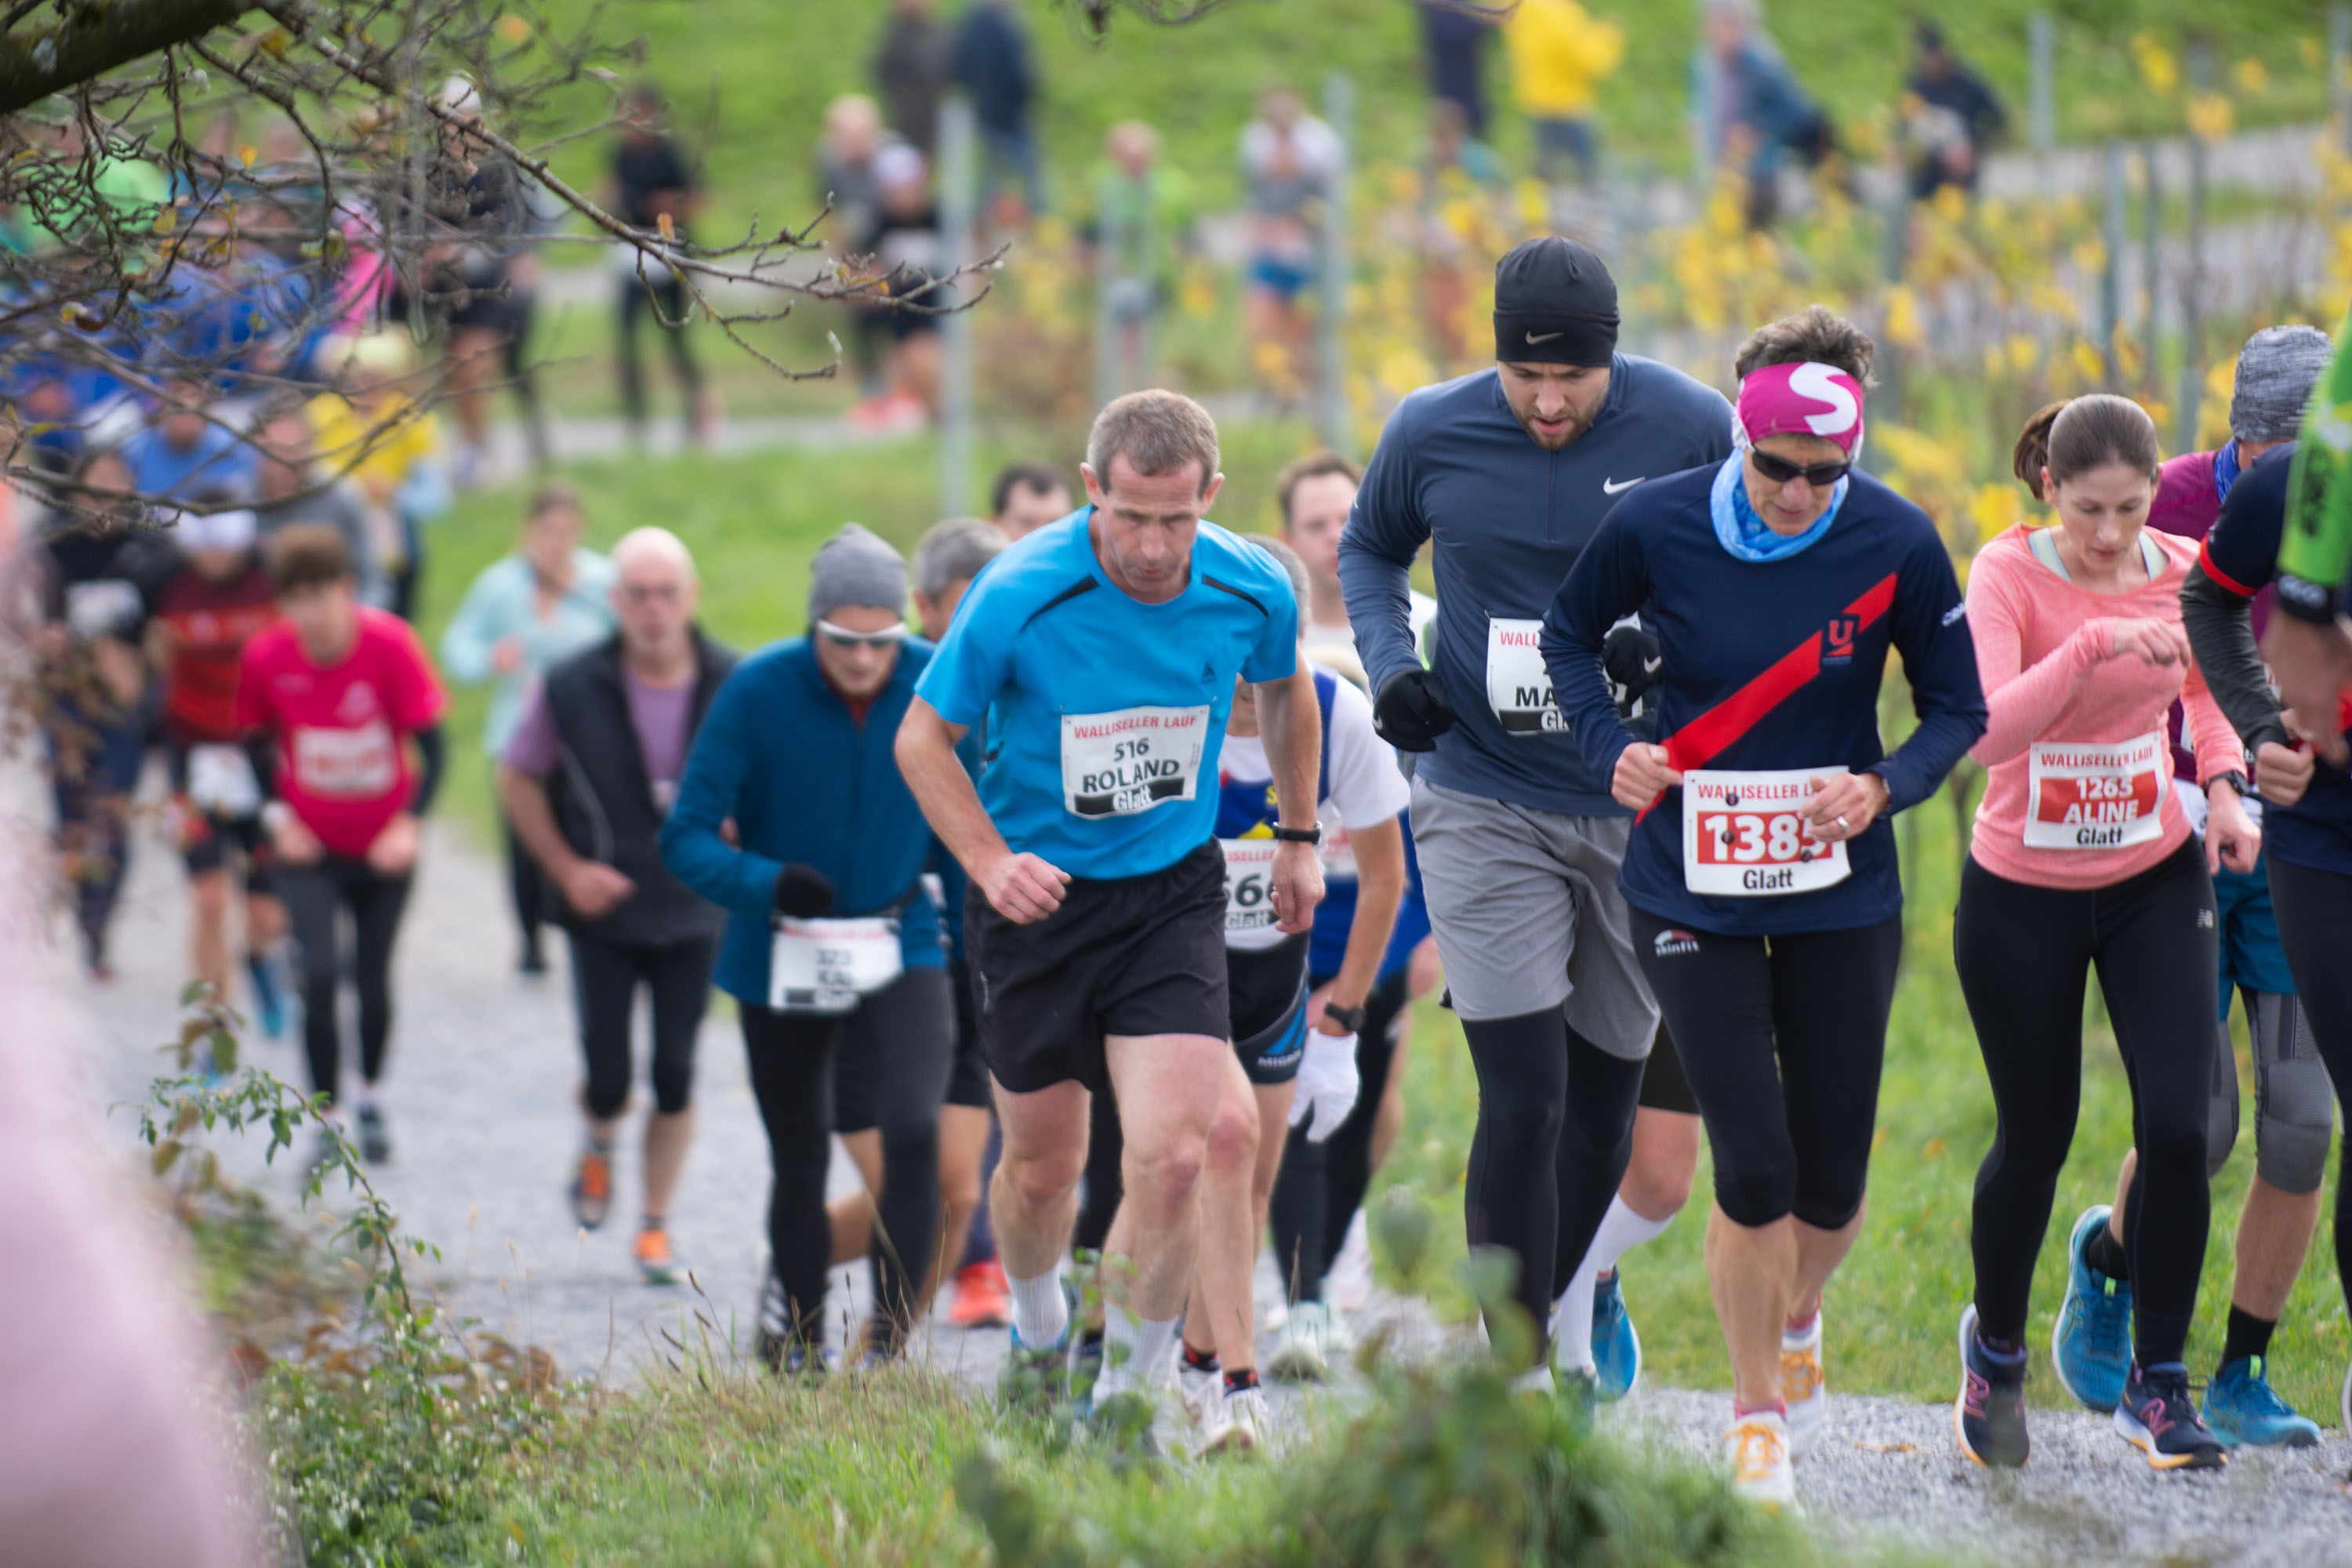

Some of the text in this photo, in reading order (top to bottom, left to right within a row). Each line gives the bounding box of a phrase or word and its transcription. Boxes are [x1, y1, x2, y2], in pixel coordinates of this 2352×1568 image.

[1073, 714, 1198, 739] WALLISELLER LAUF
[1541, 710, 1570, 731] Gl
[1113, 737, 1150, 762] 516
[2041, 752, 2129, 768] WALLISELLER
[1083, 759, 1180, 793] ROLAND
[2076, 776, 2133, 800] 1265
[1112, 784, 1154, 812] Glatt
[1697, 782, 1798, 800] WALLISELLER
[2063, 799, 2140, 825] ALINE
[2076, 826, 2123, 844] Glatt
[1742, 868, 1793, 890] Glatt
